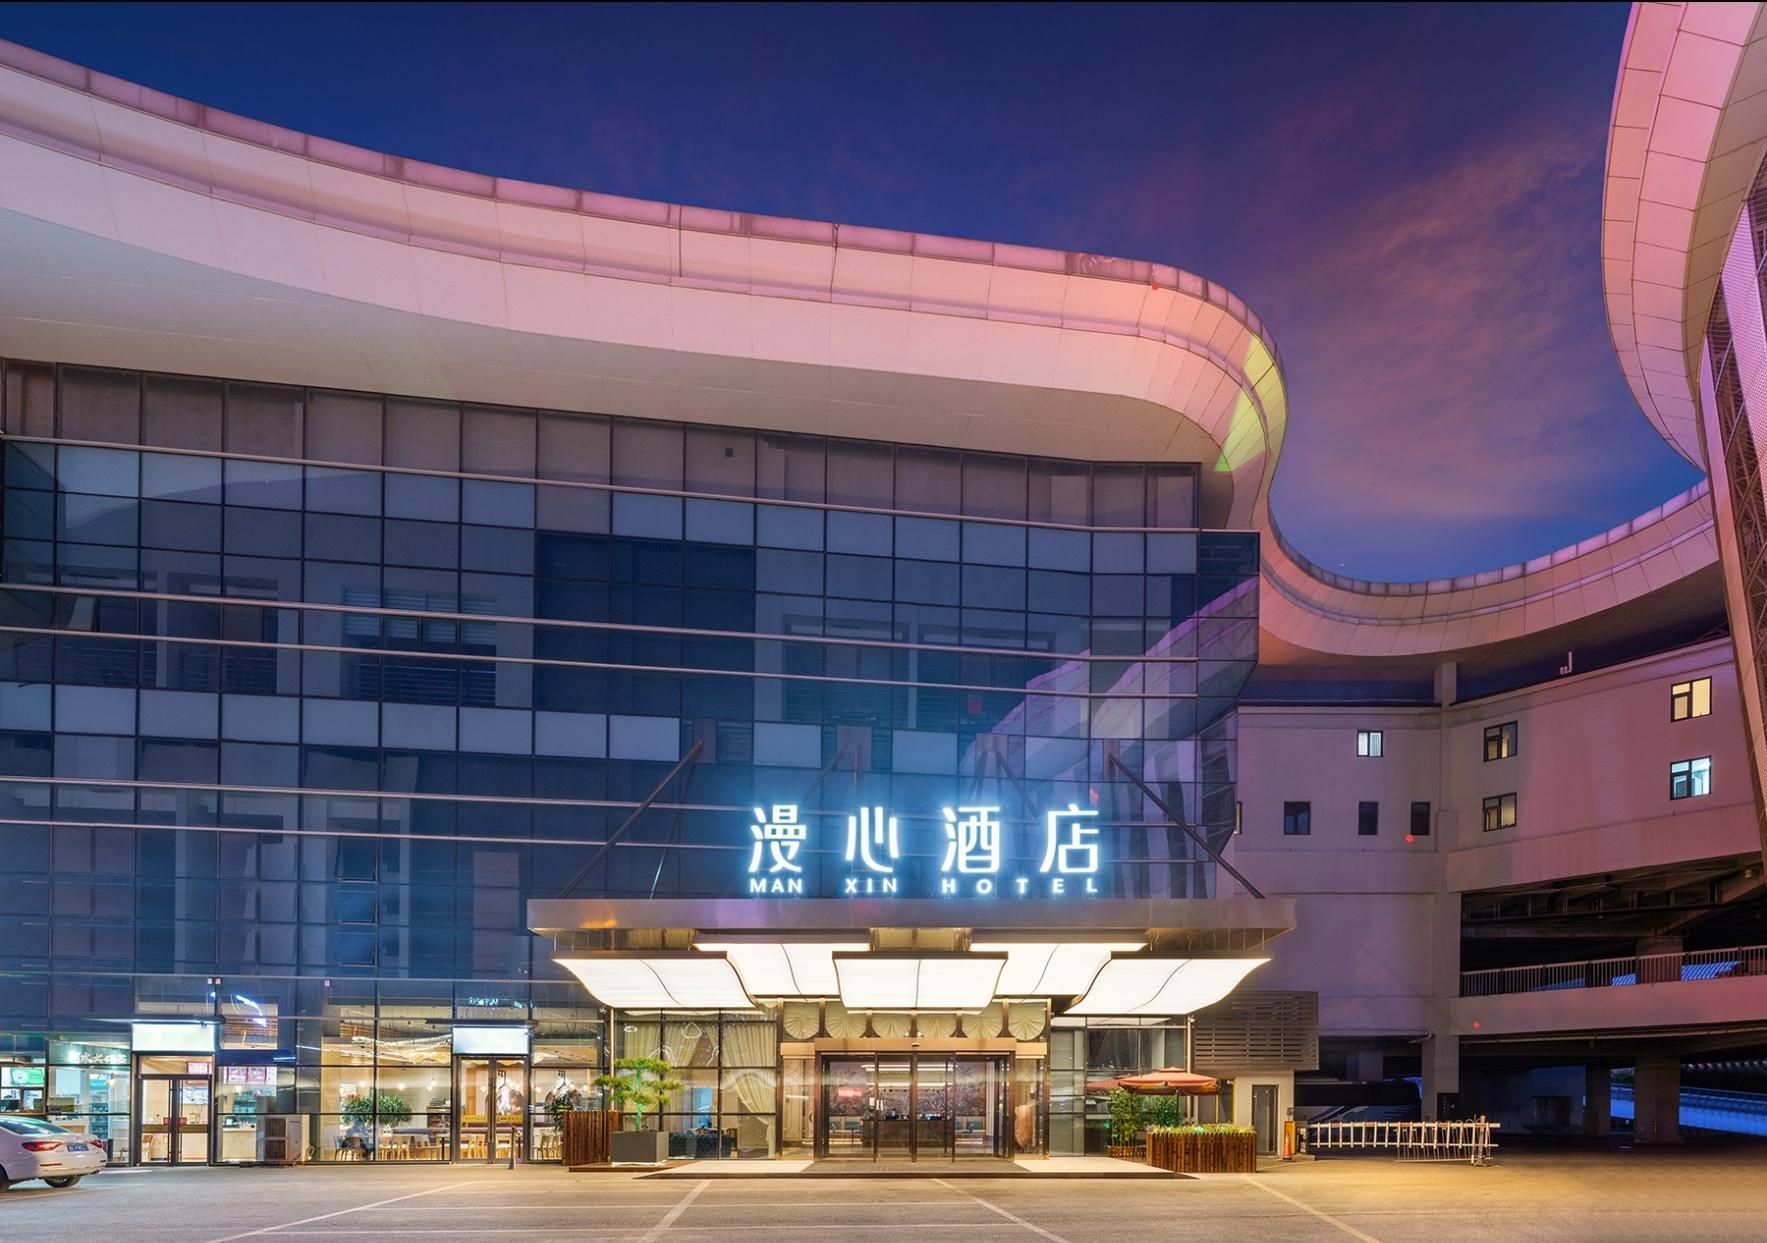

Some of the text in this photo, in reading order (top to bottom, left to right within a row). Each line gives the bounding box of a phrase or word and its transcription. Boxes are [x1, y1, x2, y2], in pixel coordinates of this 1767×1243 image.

[749, 804, 1098, 873] 漫心酒店
[750, 878, 1098, 893] MAN XIN HOTEL
